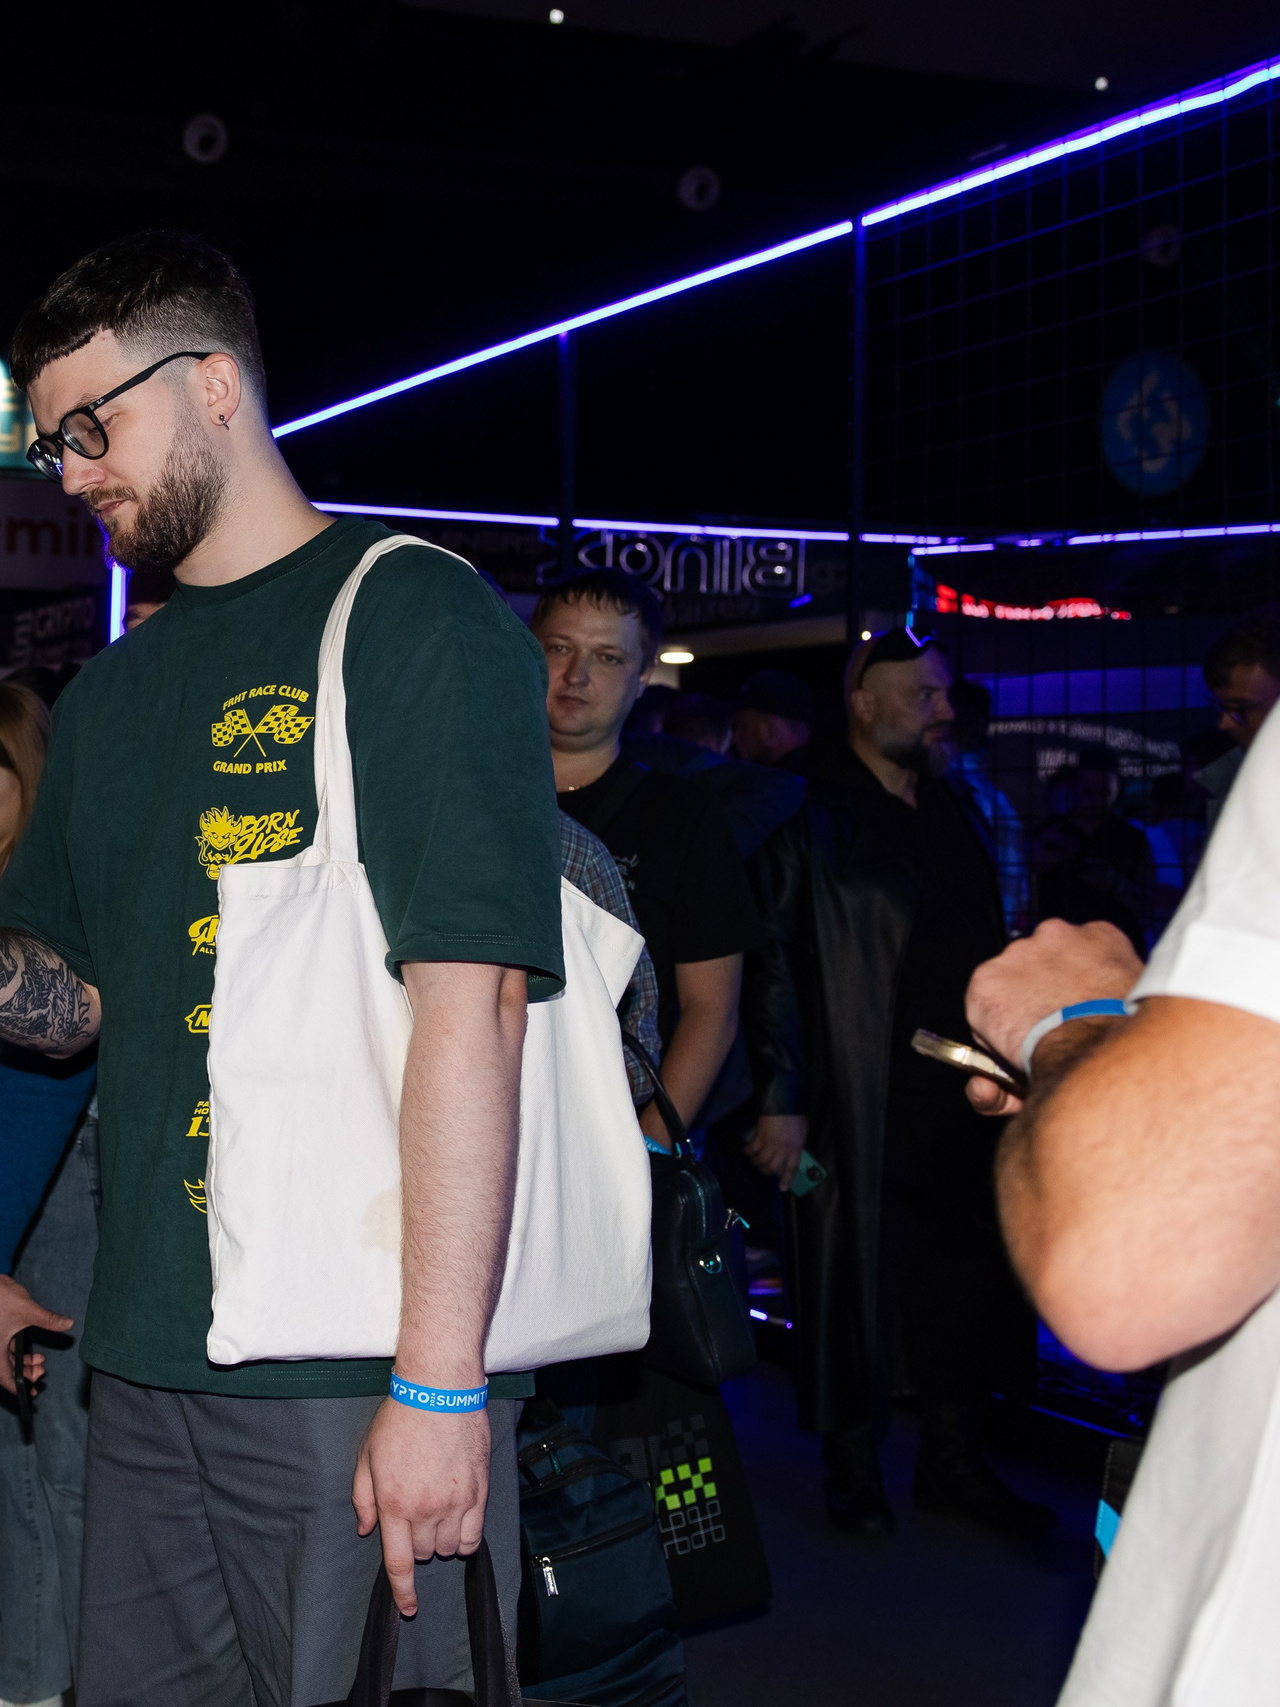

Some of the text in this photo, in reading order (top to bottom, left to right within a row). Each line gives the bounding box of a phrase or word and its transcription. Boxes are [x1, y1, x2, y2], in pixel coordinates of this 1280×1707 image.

[223, 684, 309, 711] FRHT RACE CLUB
[213, 759, 287, 774] GRAND PRIX
[436, 1390, 486, 1407] SUMMIT
